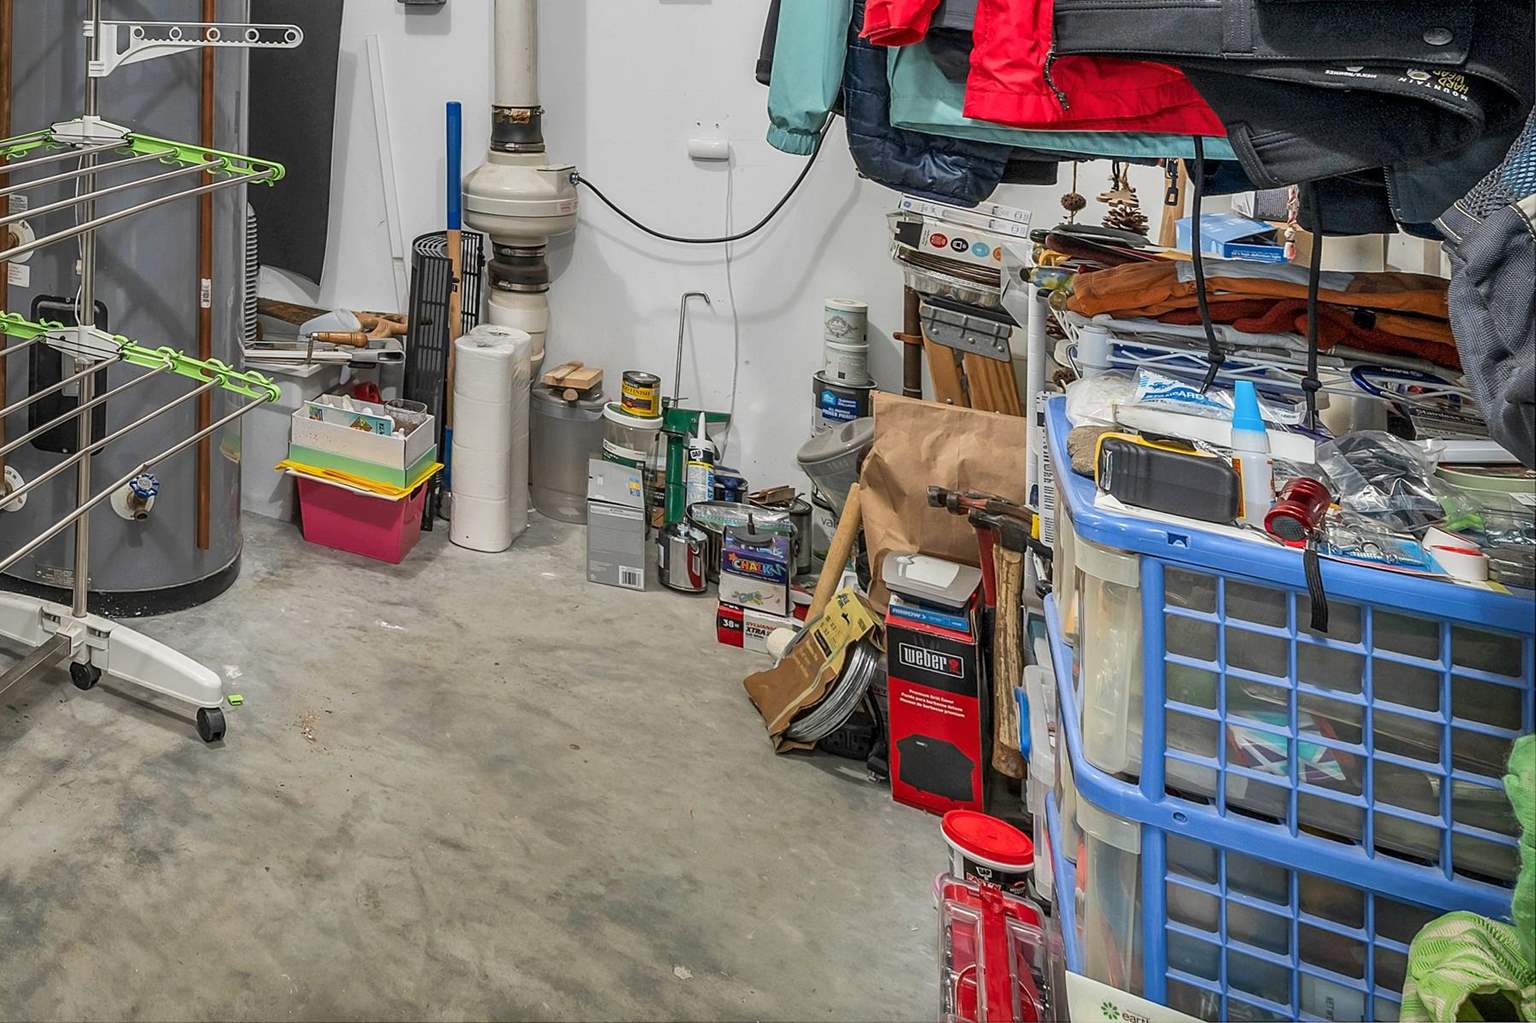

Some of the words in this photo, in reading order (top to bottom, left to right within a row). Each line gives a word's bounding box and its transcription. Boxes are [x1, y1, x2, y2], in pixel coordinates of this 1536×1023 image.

[1398, 77, 1468, 102] MOUNTAIN
[1438, 78, 1469, 94] HARD
[904, 646, 947, 672] weber
